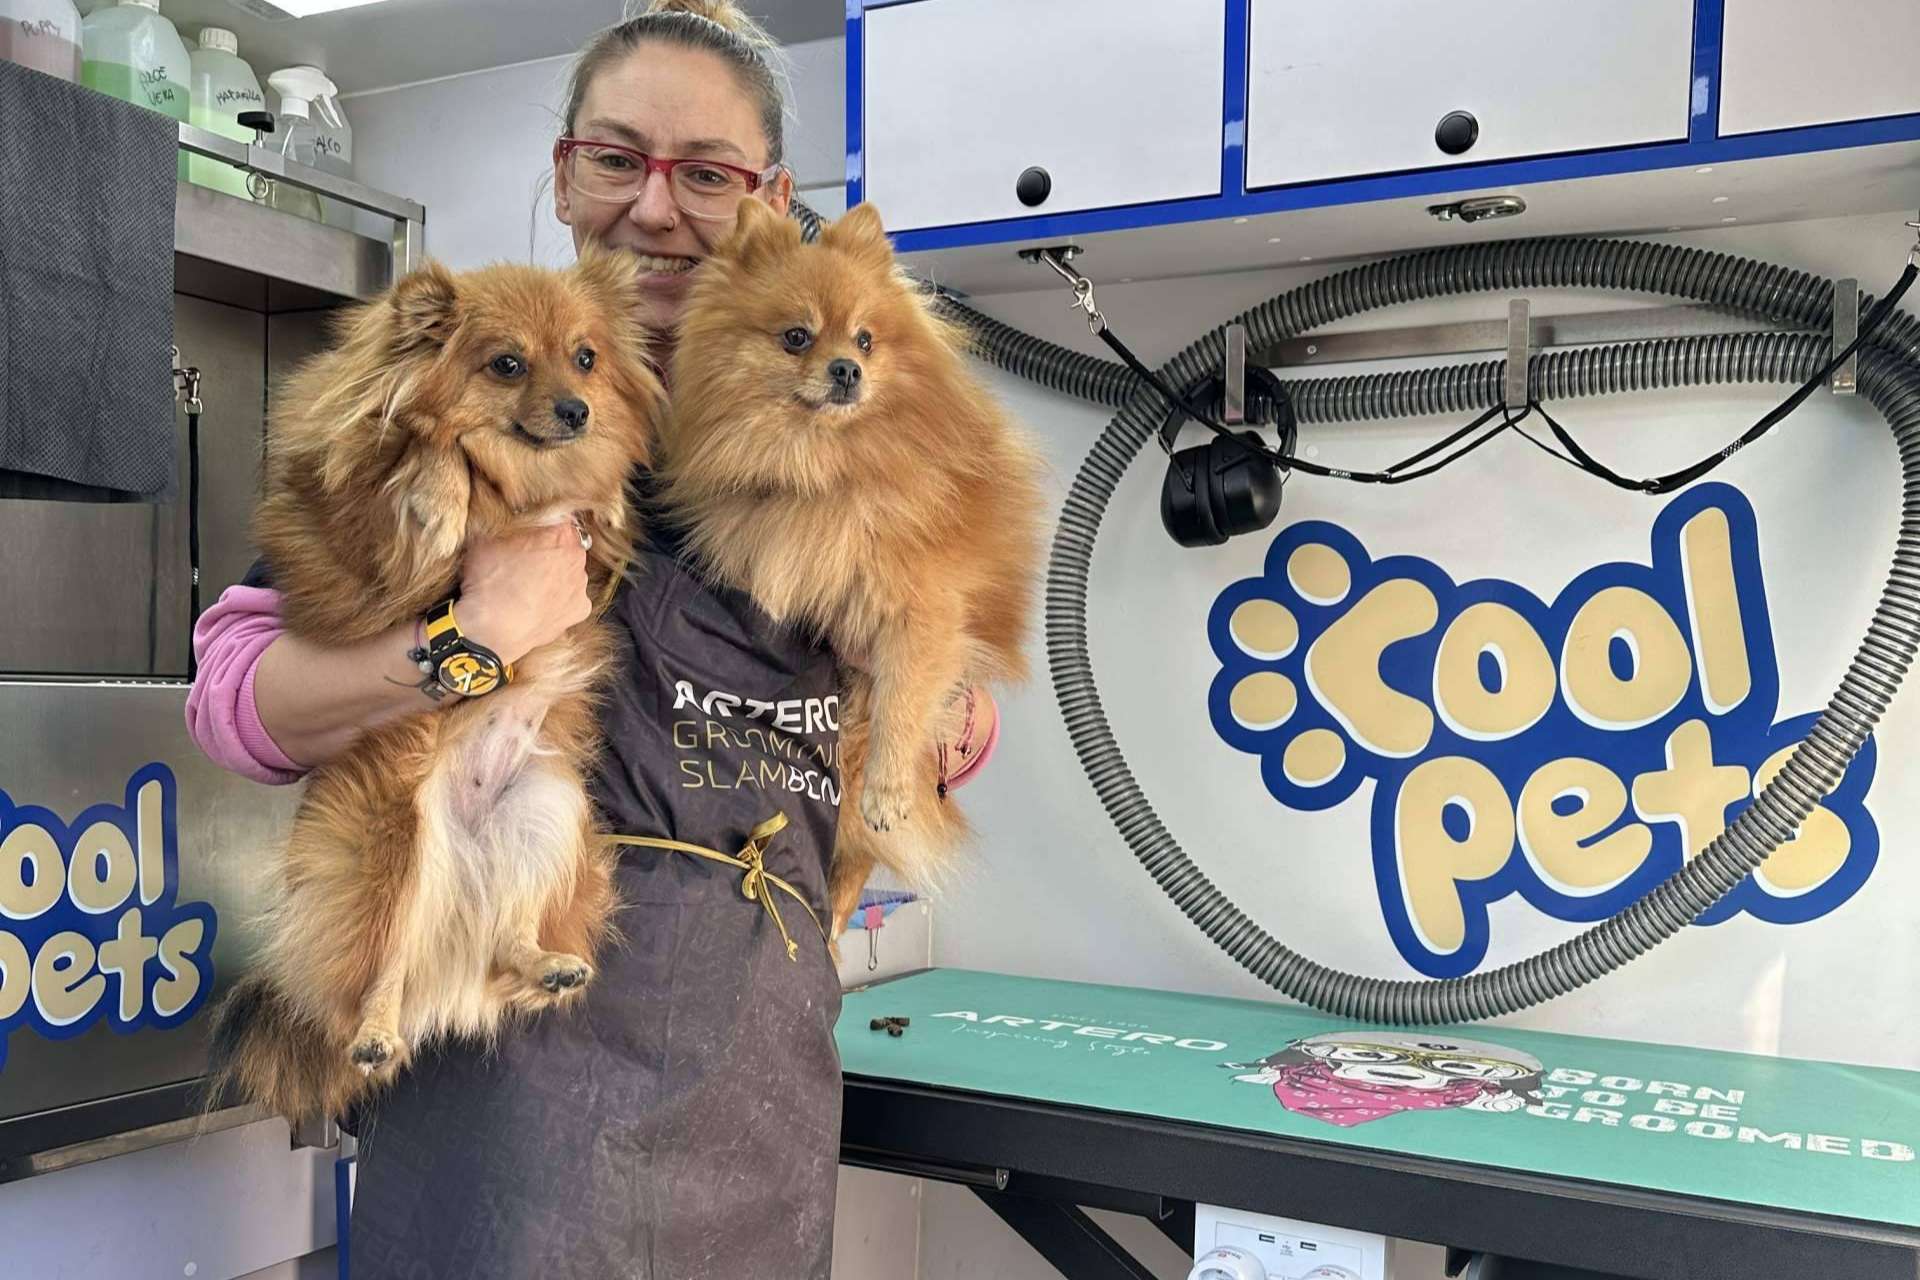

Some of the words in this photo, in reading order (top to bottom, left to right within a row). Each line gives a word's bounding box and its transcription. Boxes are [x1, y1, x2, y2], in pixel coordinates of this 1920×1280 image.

[0, 779, 165, 920] ool
[929, 1010, 1228, 1052] ARTERO
[1548, 1067, 1745, 1105] BORN
[1526, 1101, 1915, 1161] GROOMED
[1653, 1098, 1741, 1122] BE
